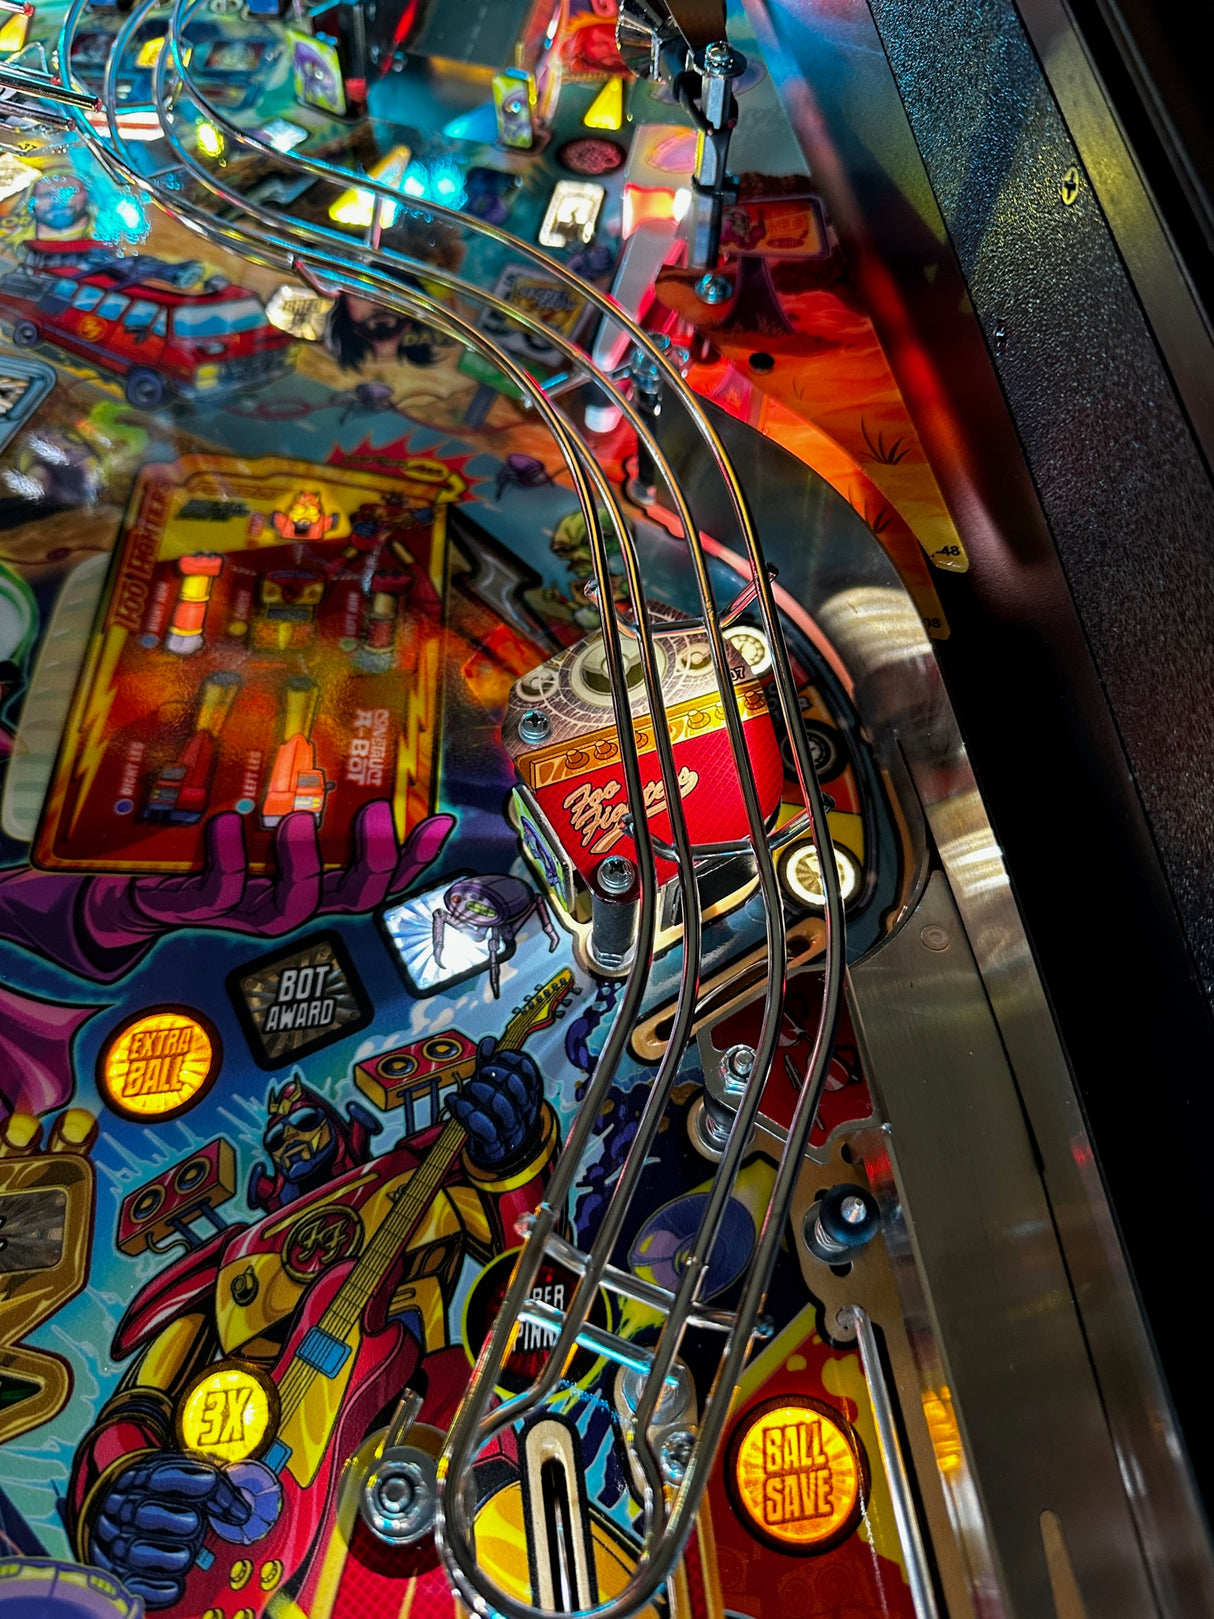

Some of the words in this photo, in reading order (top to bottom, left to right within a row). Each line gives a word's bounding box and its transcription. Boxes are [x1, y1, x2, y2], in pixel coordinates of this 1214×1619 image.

[346, 708, 373, 786] A-BOT
[366, 708, 390, 786] CONSTRUCT
[243, 771, 259, 798] LEFT
[563, 779, 622, 826] Foo
[279, 965, 331, 1001] BOT
[265, 999, 334, 1032] AWARD
[129, 1027, 193, 1060] EXTRA
[123, 1055, 185, 1097] BALL
[198, 1388, 253, 1446] 3X
[764, 1421, 828, 1474] BALL
[765, 1468, 833, 1523] SAVE
